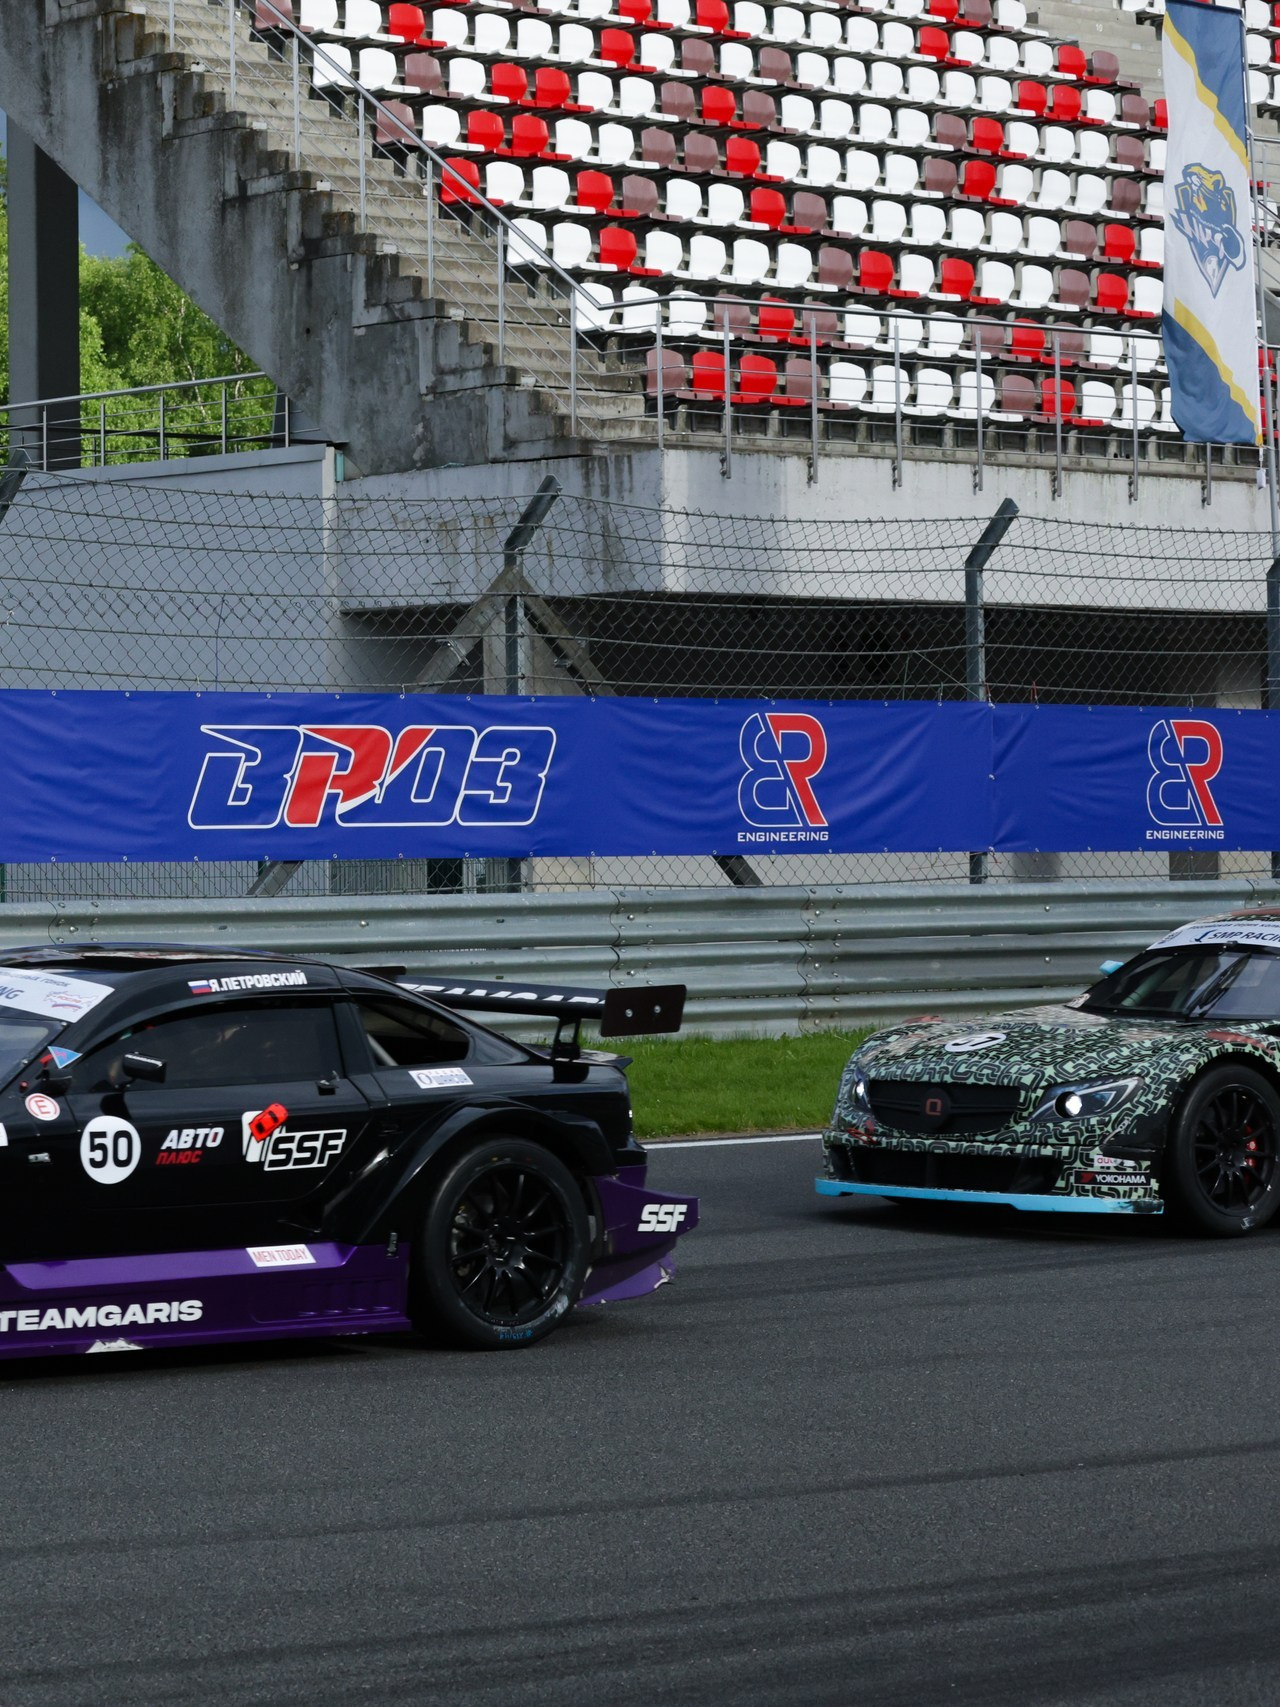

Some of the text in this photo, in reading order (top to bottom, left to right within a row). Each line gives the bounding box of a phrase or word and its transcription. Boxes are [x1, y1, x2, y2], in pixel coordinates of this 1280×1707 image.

[737, 831, 829, 843] ENGINEERING
[1145, 829, 1225, 840] ENGINEERING
[1208, 931, 1244, 940] SMP
[33, 1099, 51, 1115] E
[160, 1127, 224, 1150] АВТО
[87, 1129, 134, 1169] 50
[264, 1129, 347, 1171] SSF
[155, 1150, 203, 1165] ПЛЮС
[1095, 1174, 1147, 1184] YOKOHAMA
[637, 1204, 688, 1232] SSF
[274, 1248, 308, 1262] TODAY
